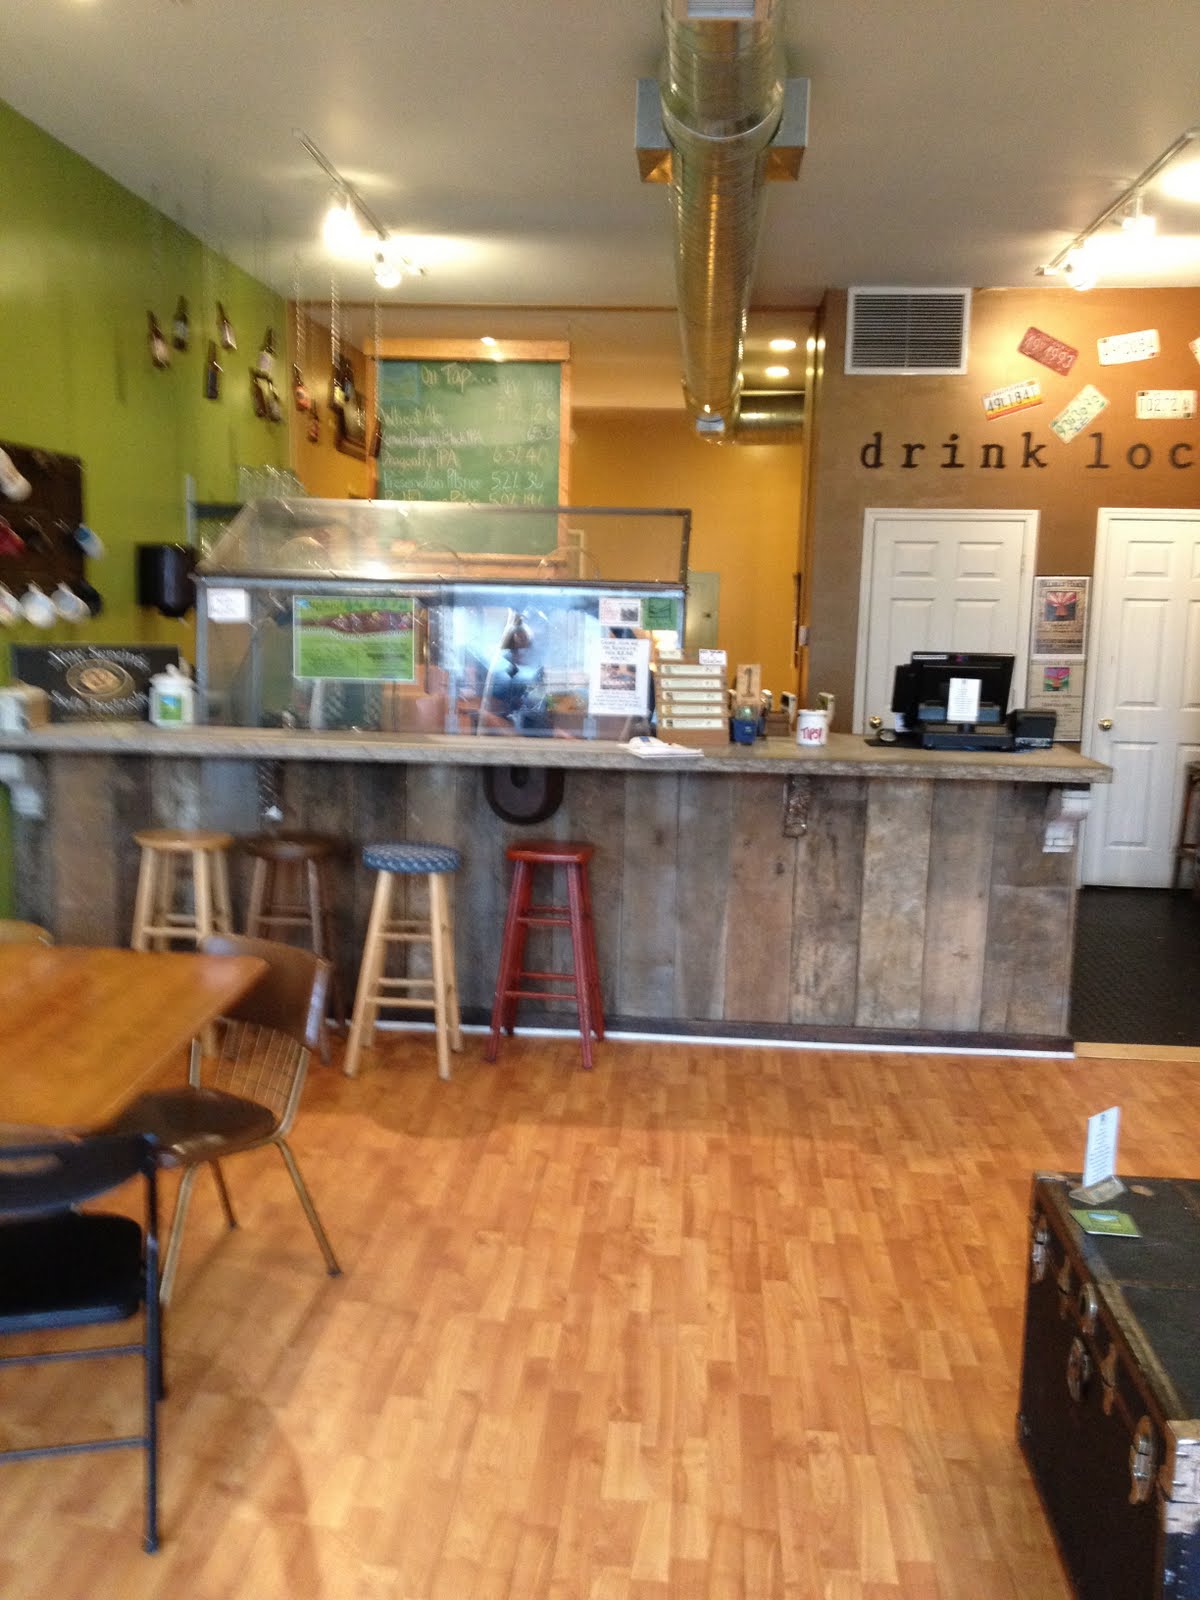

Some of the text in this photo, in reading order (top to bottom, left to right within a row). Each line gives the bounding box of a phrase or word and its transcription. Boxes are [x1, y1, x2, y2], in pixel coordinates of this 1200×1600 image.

[420, 364, 437, 386] On
[436, 448, 459, 468] IPA
[860, 431, 1194, 469] drink loc
